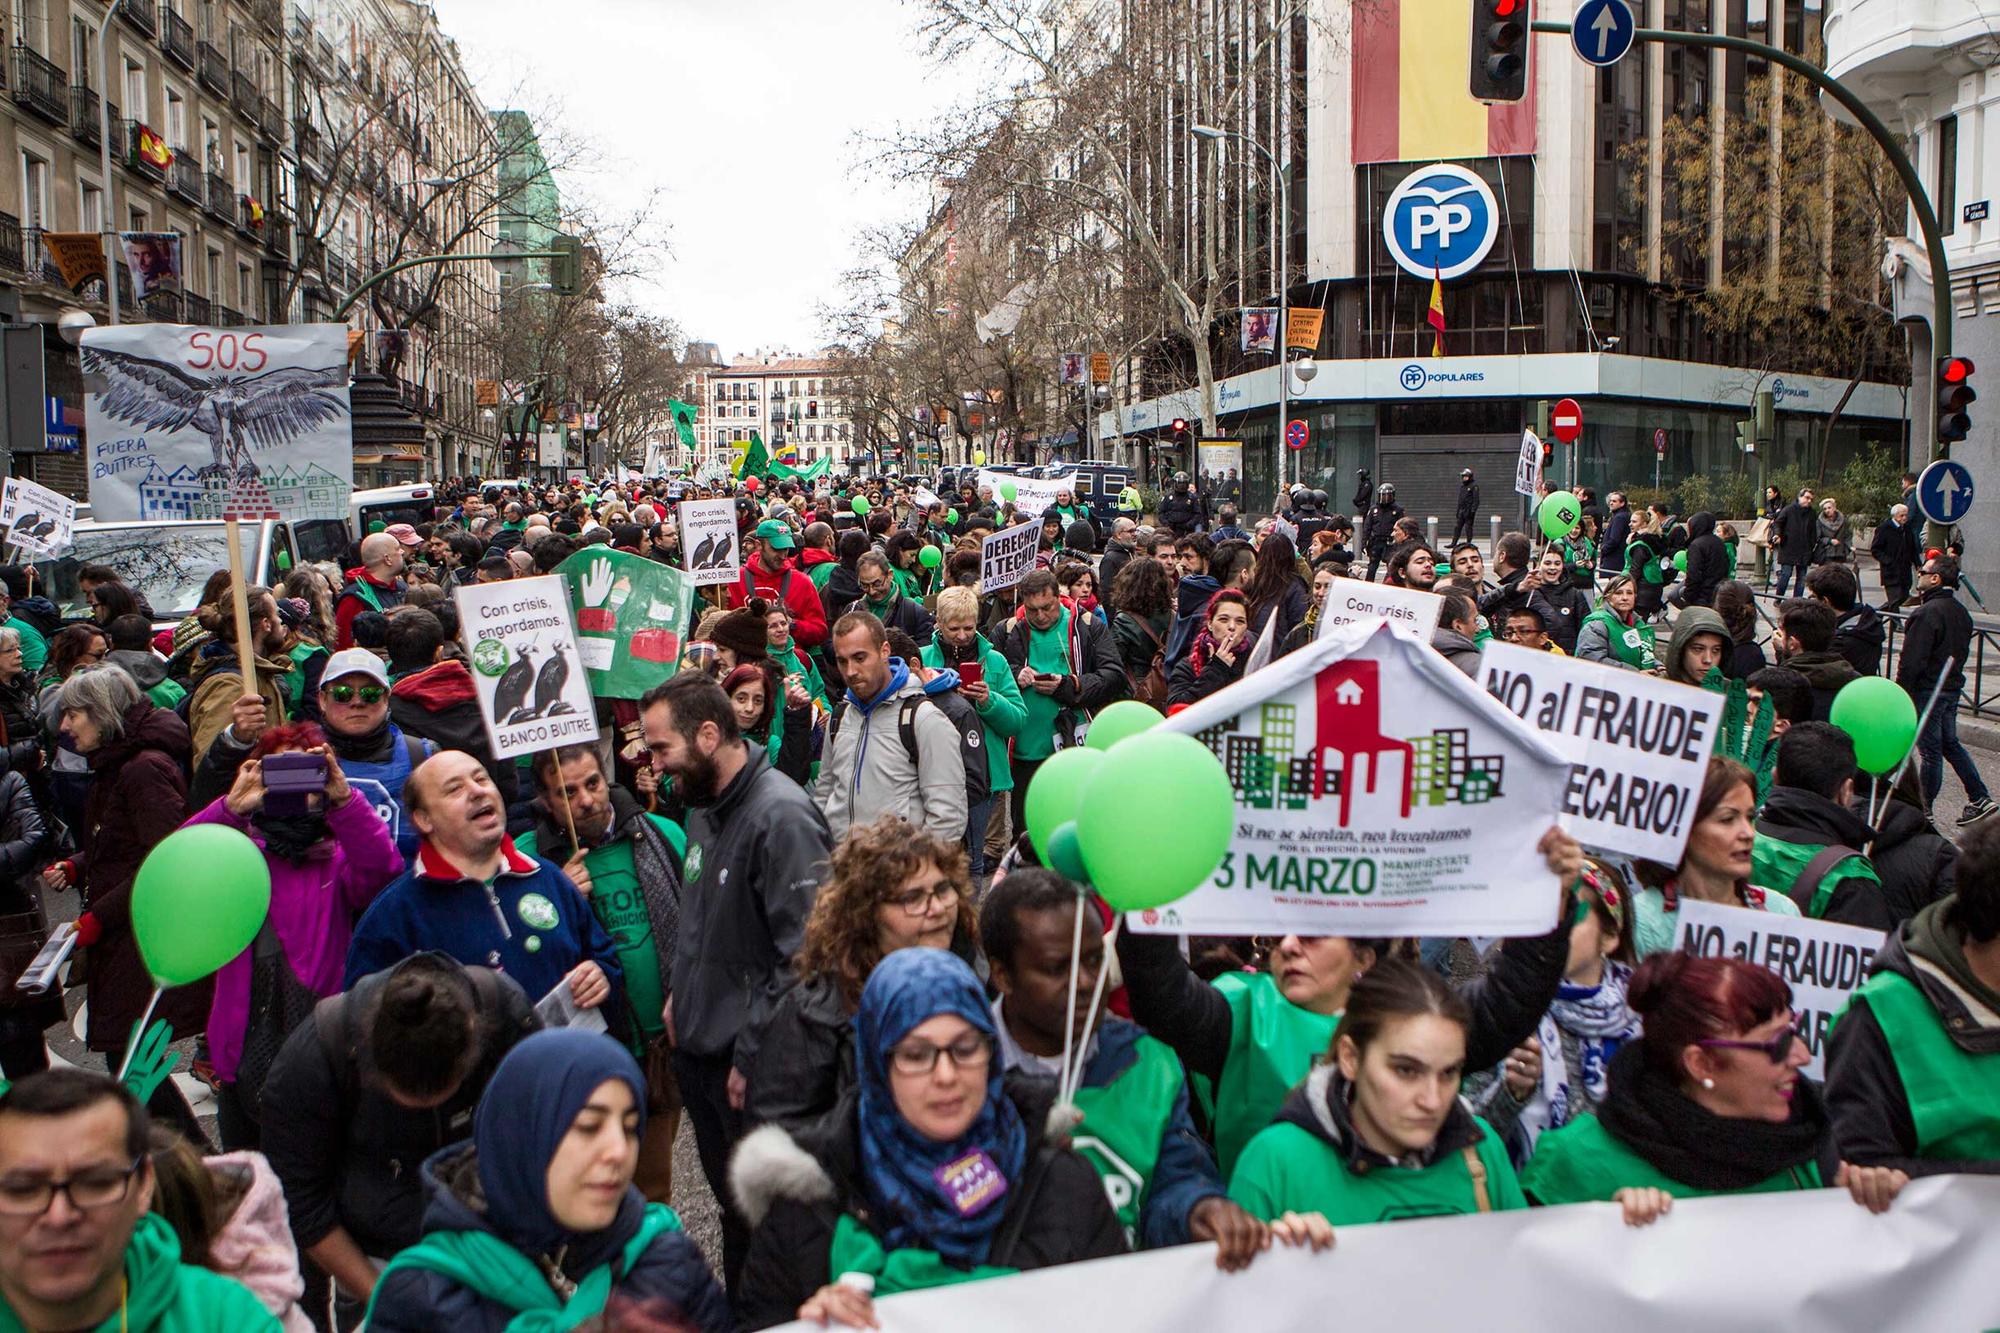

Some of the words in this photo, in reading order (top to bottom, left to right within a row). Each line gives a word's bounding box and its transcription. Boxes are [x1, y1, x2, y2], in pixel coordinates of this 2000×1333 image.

[1411, 204, 1472, 250] PP
[1405, 373, 1421, 385] PP
[1428, 372, 1484, 382] POPULARES
[96, 437, 148, 457] FUERA
[692, 510, 706, 518] Con
[985, 526, 1039, 560] DERECHO
[984, 561, 993, 579] A
[995, 544, 1036, 575] TECHO
[696, 571, 717, 581] ANCO
[718, 570, 738, 579] BUITRE
[984, 580, 989, 590] A
[990, 573, 1015, 587] JUSTO
[480, 605, 510, 619] Con
[513, 597, 552, 613] crisis,
[1346, 596, 1374, 613] Con
[478, 616, 565, 640] engordamos.
[1487, 668, 1533, 720] NO
[1537, 682, 1572, 732] al
[1573, 686, 1710, 762] FRAUDE
[499, 726, 548, 749] BANCO
[1561, 762, 1691, 837] ECARIO!
[1237, 822, 1254, 840] Si
[1361, 830, 1387, 842] nos
[1390, 827, 1472, 843] levantamos
[1245, 852, 1377, 896] MARZO
[596, 886, 646, 918] TOP
[1683, 922, 1725, 960] NO
